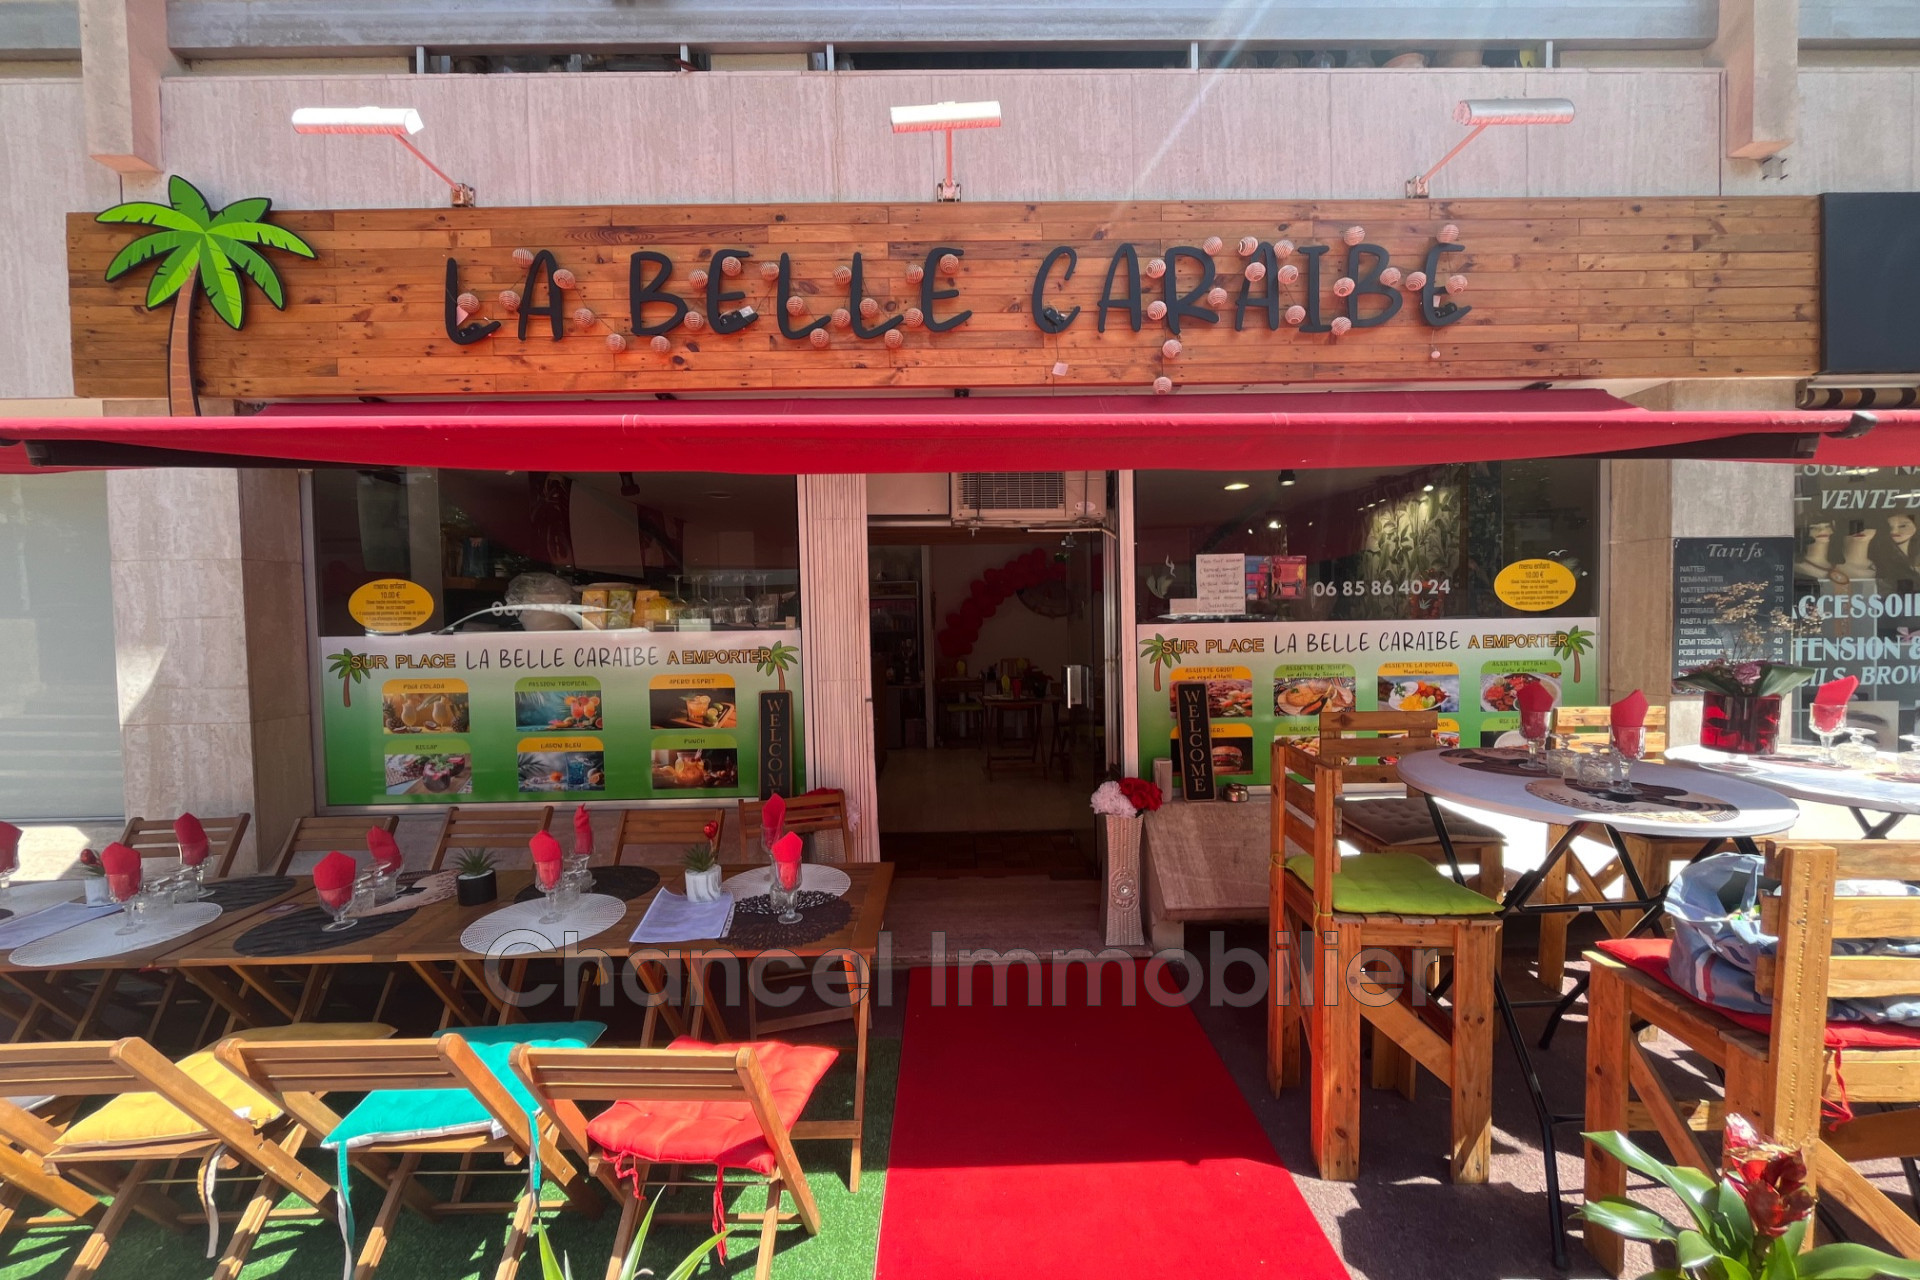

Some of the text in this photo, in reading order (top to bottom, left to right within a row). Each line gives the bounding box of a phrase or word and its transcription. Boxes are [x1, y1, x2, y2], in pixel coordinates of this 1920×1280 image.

[446, 242, 1472, 345] LA BELLE CARAIBE
[1821, 489, 1899, 510] VENTE
[1707, 542, 1764, 562] Tarifs
[1680, 565, 1706, 573] NATTES
[1313, 578, 1451, 597] 06 85 86 40 24
[1680, 627, 1707, 635] TISSAGE
[1162, 630, 1569, 655] SUR PLACE LA BELLE CARAIBE A EMPORTER
[1679, 638, 1696, 646] DEMI
[1773, 637, 1783, 645] 40
[351, 646, 773, 670] SUR PLACE LA BELLE CARAIBE A EMPORTER
[1679, 648, 1696, 656] POSE
[684, 737, 706, 745] PUNCH
[1184, 689, 1206, 792] WELCOME
